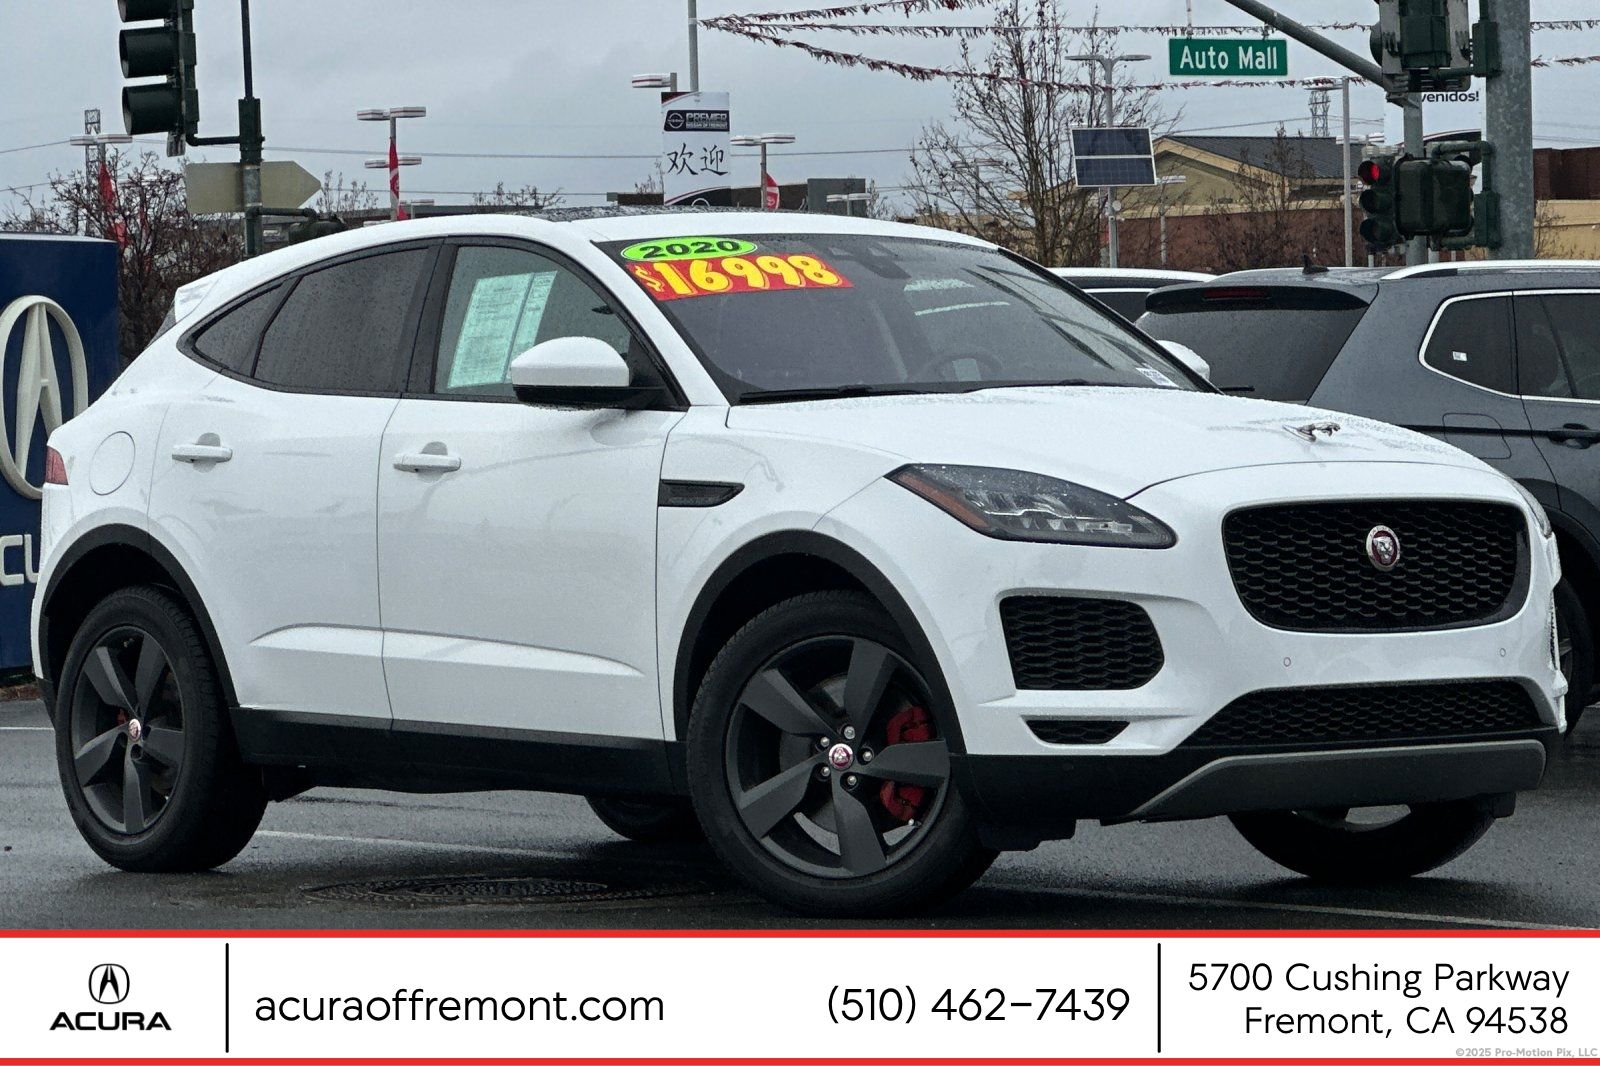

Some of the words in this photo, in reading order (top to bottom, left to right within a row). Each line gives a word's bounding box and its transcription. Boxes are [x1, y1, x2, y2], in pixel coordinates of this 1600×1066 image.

[1179, 46, 1229, 70] Auto
[1238, 46, 1278, 70] Mall
[667, 143, 729, 176] 欢迎
[639, 240, 741, 259] 2020
[635, 255, 843, 296] $16998
